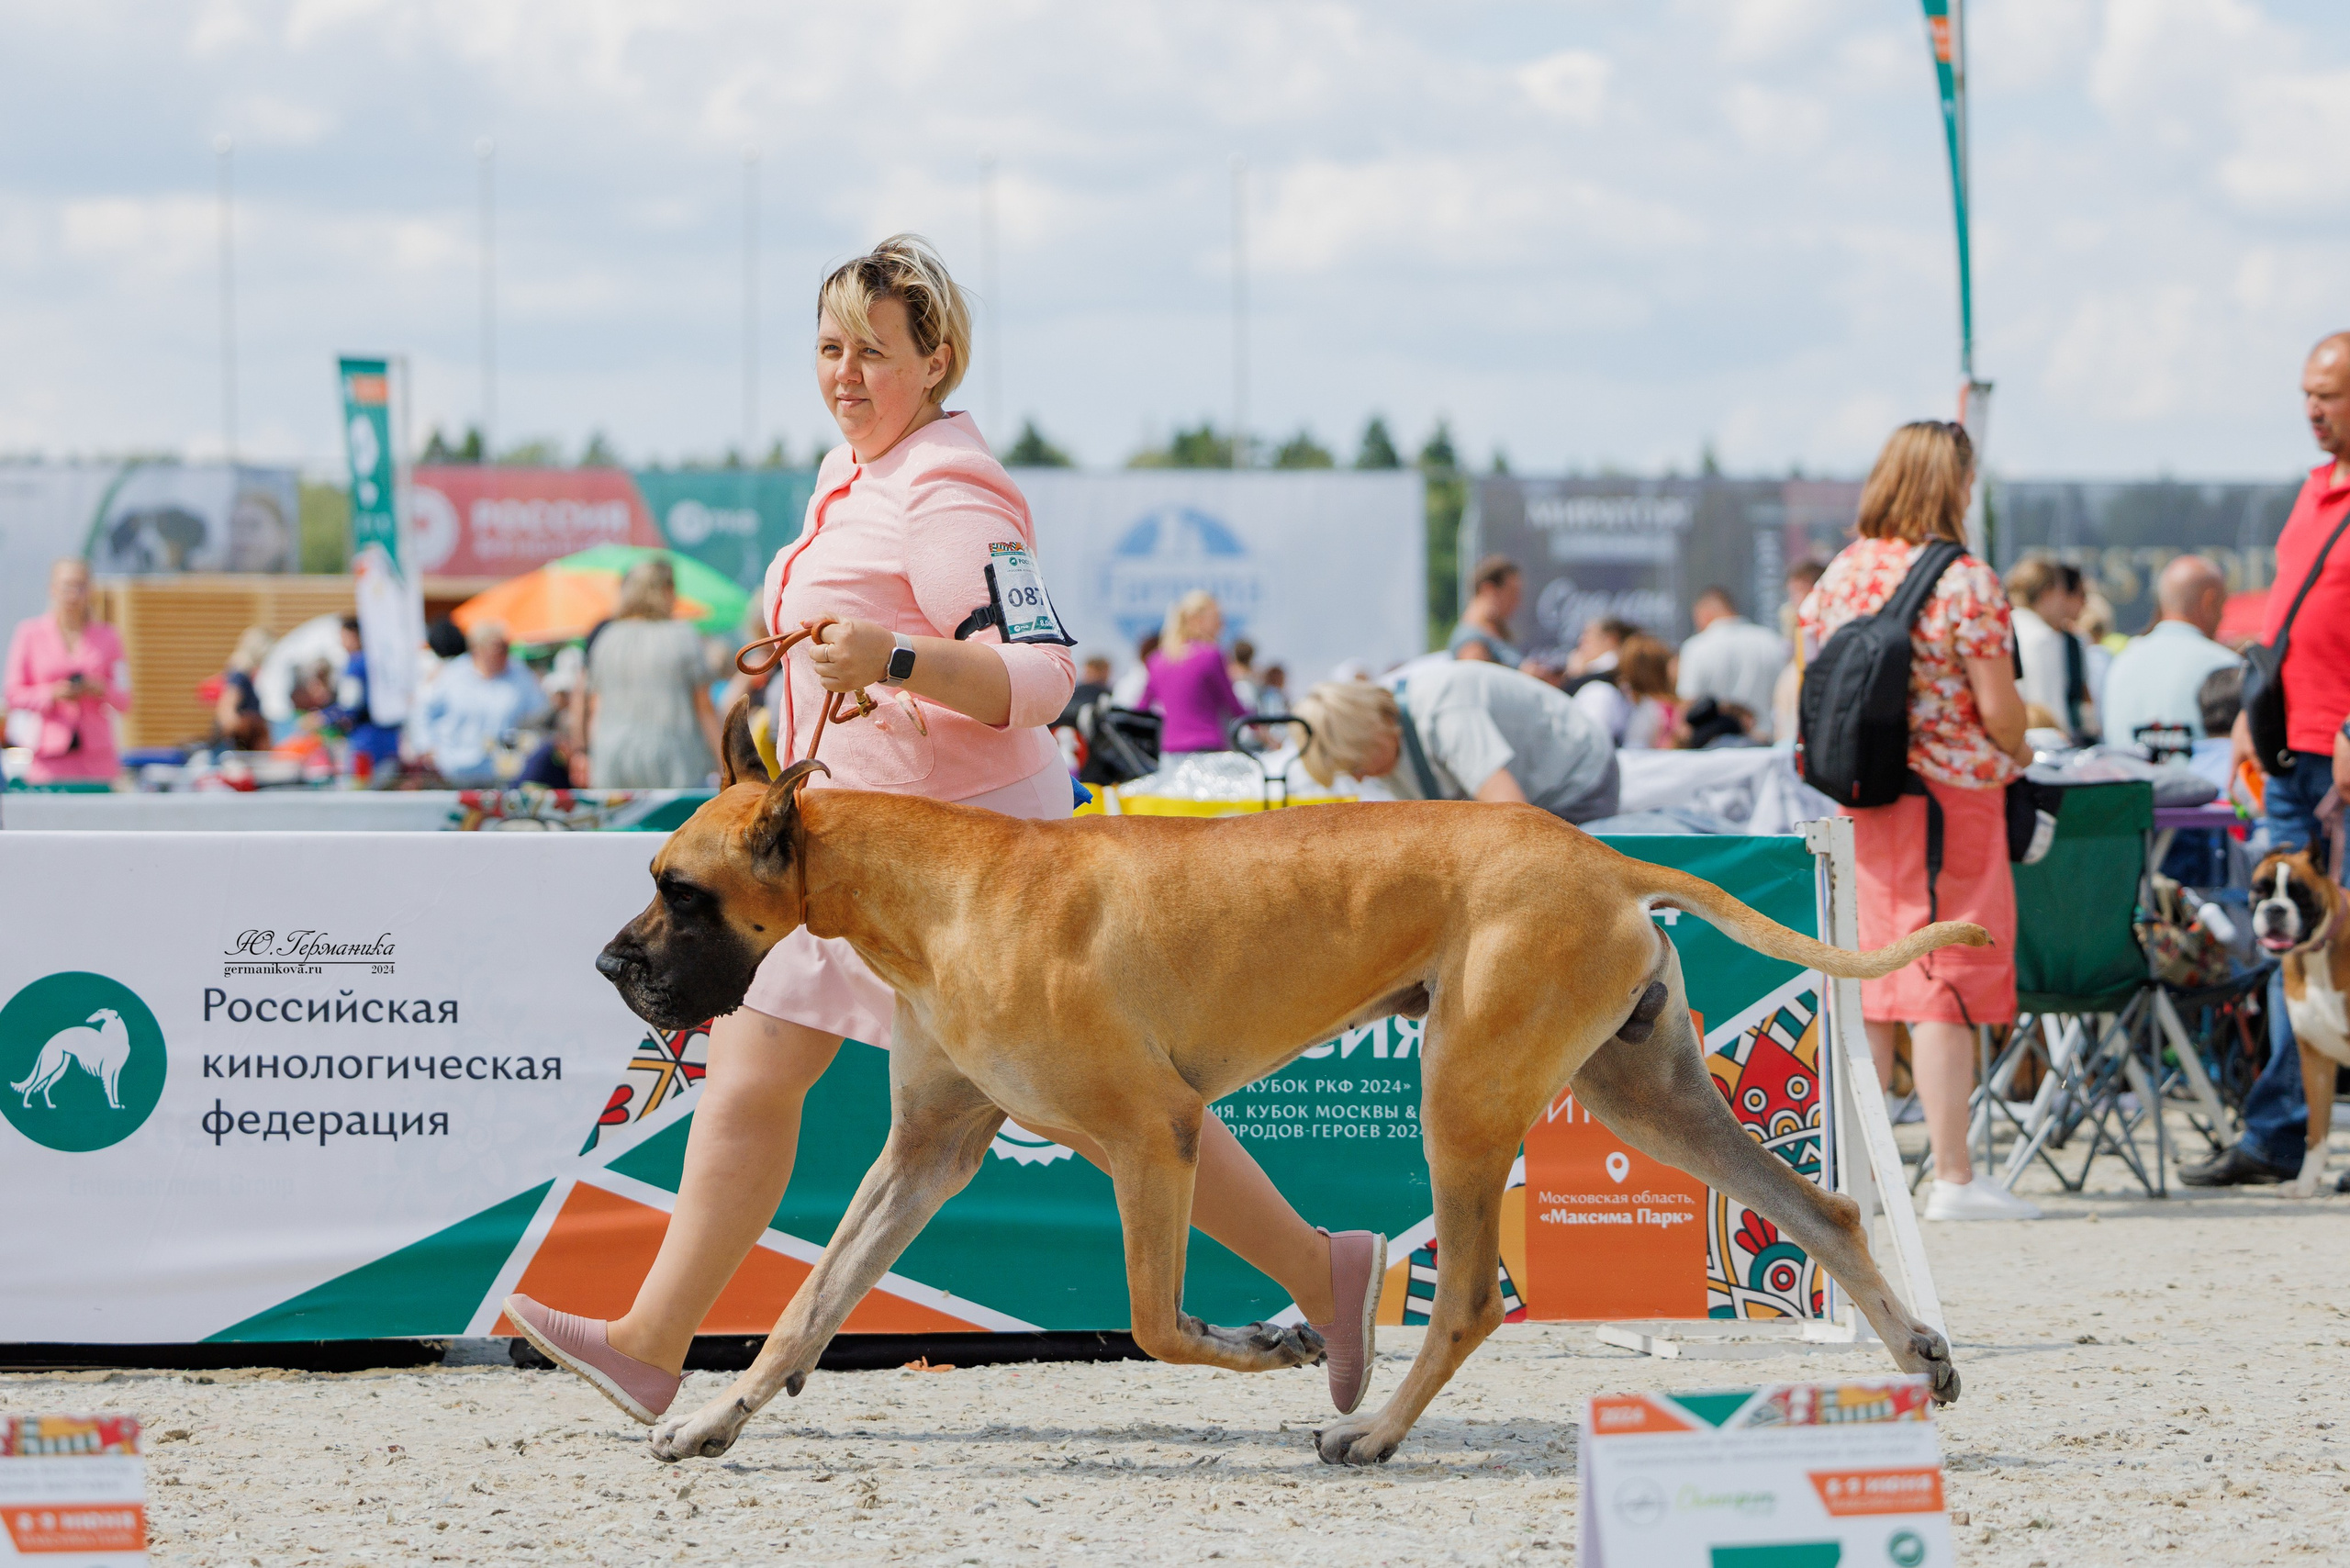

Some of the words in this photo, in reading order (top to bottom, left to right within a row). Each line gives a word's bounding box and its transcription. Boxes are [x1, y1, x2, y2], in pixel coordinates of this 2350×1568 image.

[203, 988, 459, 1024] Российская
[203, 1054, 562, 1081] кинологическая
[1247, 1079, 1309, 1093] КУБОК
[1315, 1079, 1354, 1093] РКФ
[1360, 1079, 1412, 1093] 2024»
[1247, 1104, 1309, 1119] КУБОК
[1315, 1104, 1398, 1119] МОСКВЫ
[1405, 1104, 1418, 1119] &
[202, 1098, 449, 1147] федерация
[1539, 1191, 1628, 1204] Московская
[1632, 1190, 1695, 1204] область,
[1539, 1208, 1633, 1224] «Максима
[1637, 1208, 1694, 1228] Парк»
